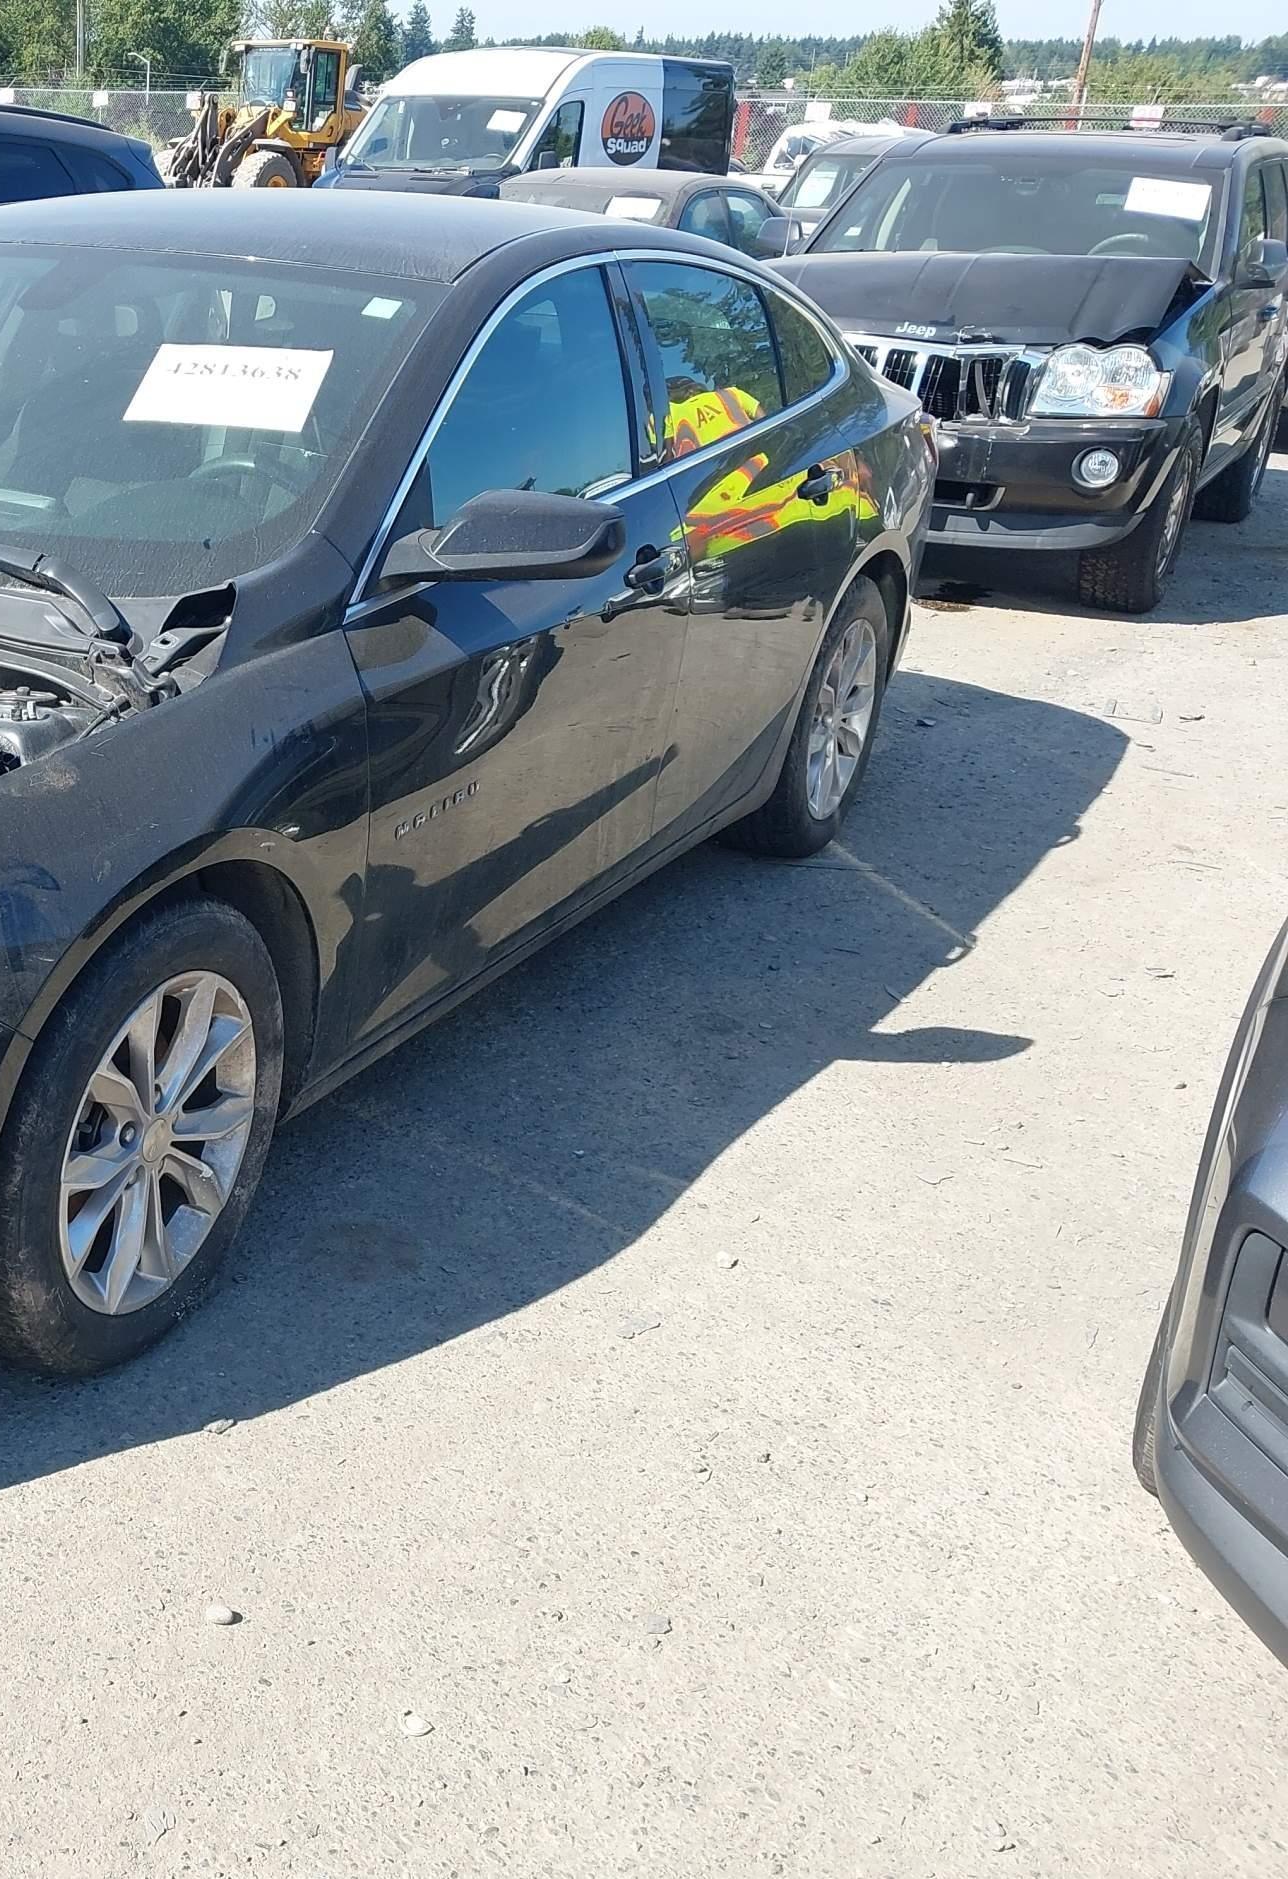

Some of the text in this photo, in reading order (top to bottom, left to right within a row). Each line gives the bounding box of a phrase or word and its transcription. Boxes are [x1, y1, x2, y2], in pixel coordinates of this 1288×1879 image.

[610, 96, 647, 137] Geek
[606, 137, 648, 155] Squad
[895, 321, 937, 339] Jeep
[167, 361, 303, 381] 42813638
